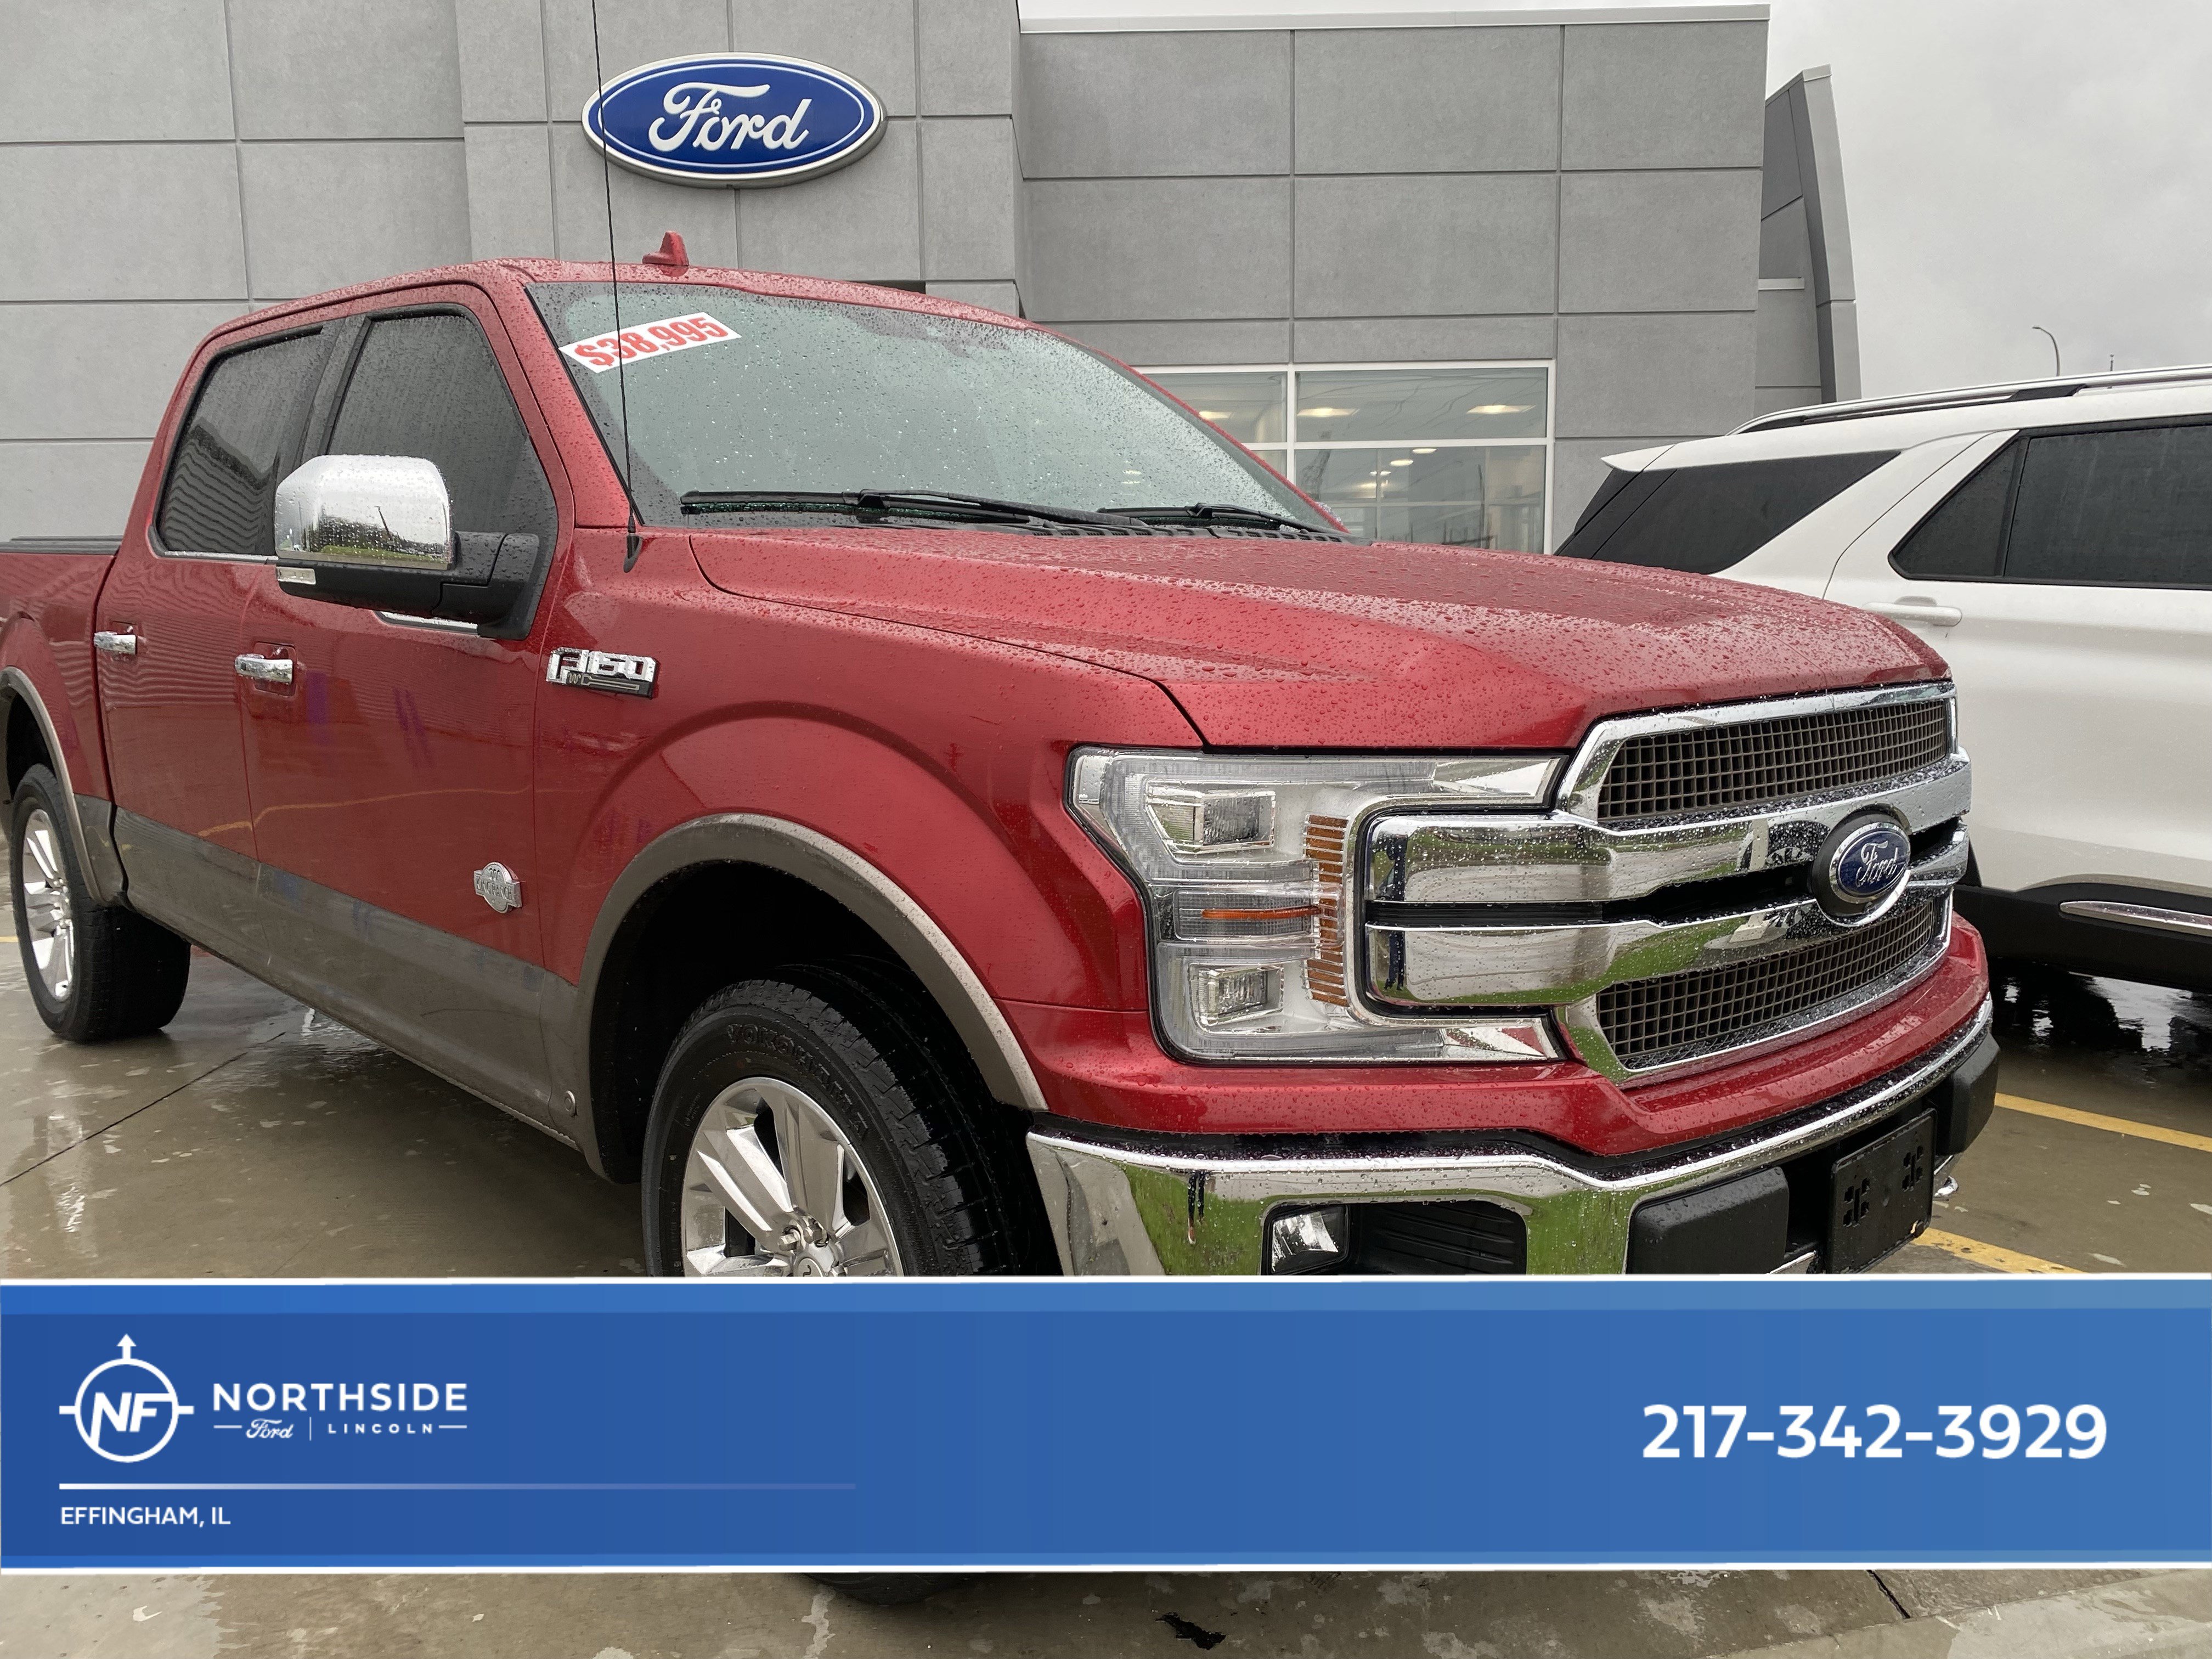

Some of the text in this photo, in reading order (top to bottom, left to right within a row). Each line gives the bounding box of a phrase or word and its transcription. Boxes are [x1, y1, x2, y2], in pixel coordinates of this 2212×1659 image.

[648, 82, 812, 152] Ford
[574, 317, 729, 367] $38,995
[476, 876, 515, 900] KING RANCH
[1855, 840, 1900, 888] Ford
